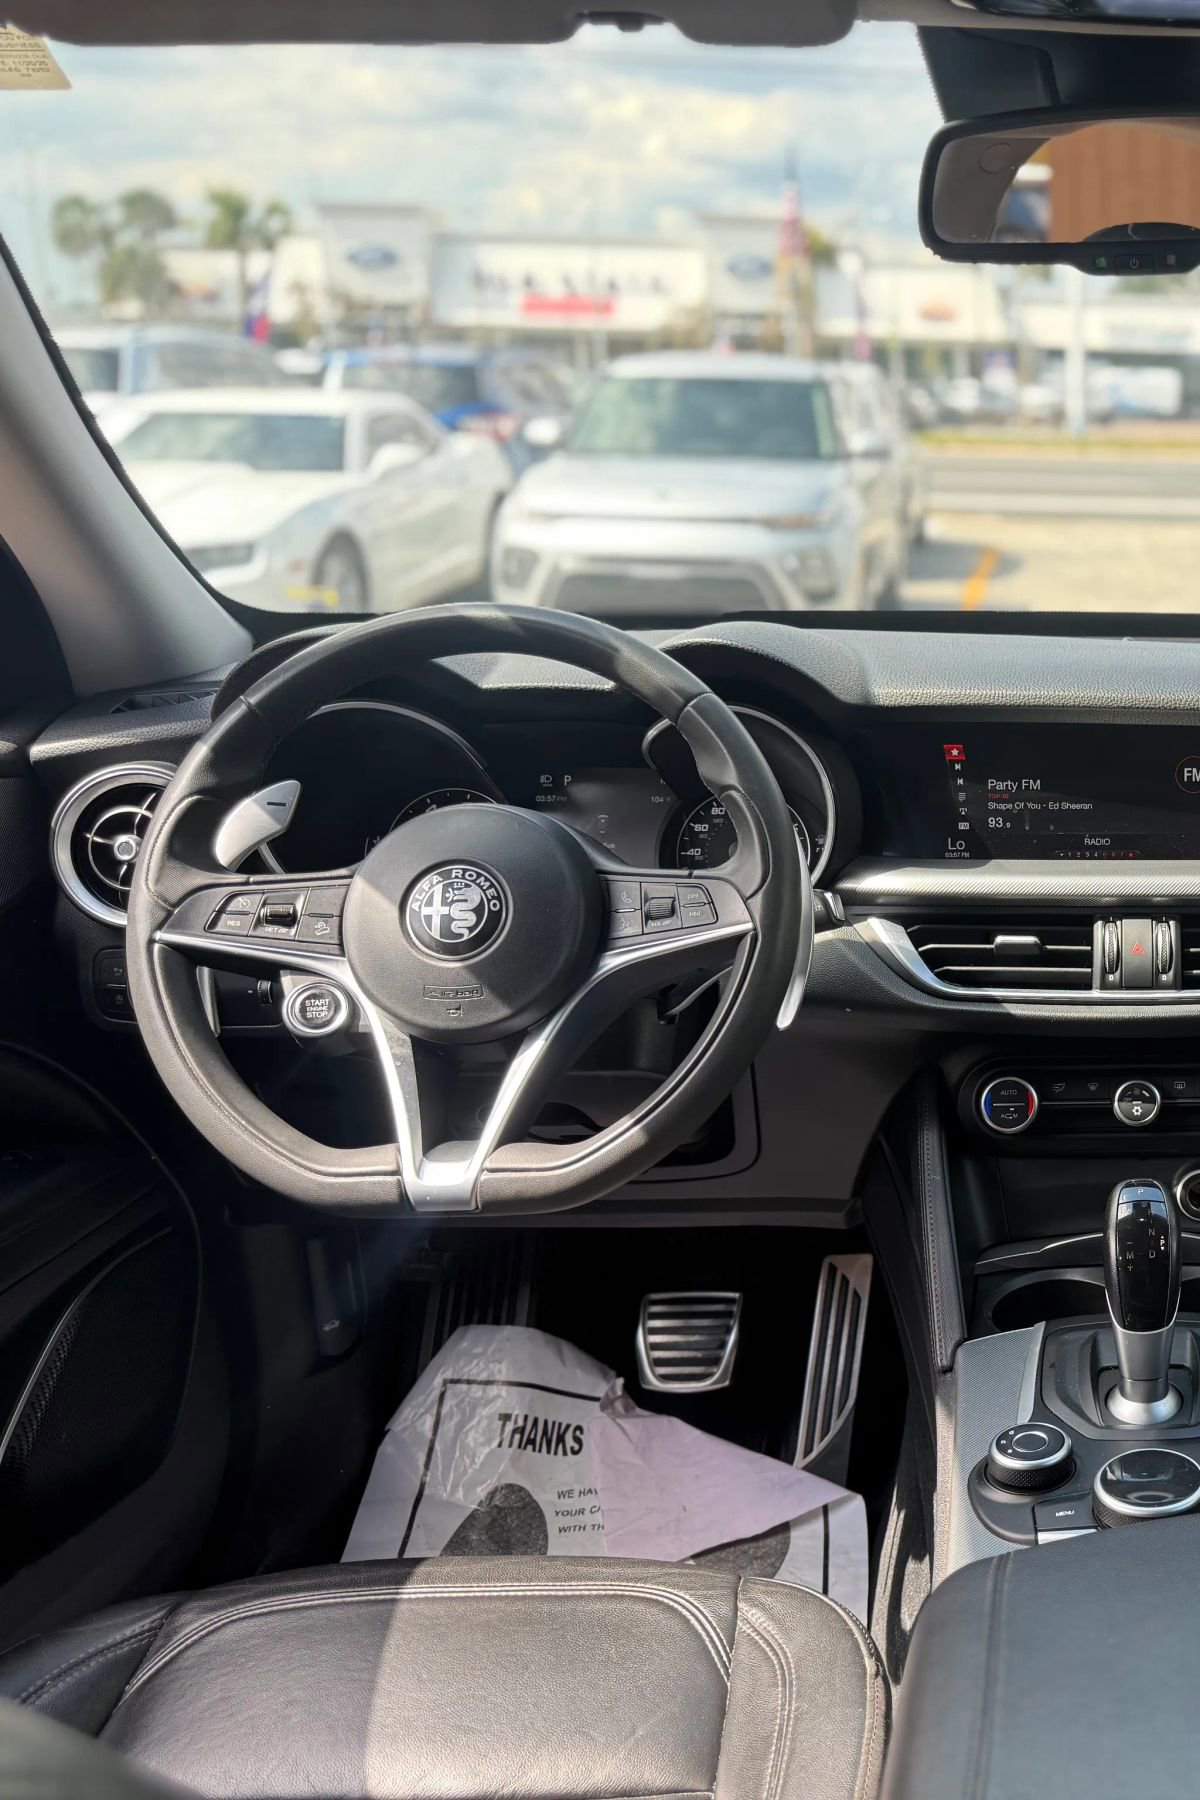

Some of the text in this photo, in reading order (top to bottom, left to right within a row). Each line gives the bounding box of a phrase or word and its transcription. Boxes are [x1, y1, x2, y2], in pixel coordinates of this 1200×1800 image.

[564, 775, 572, 786] P
[988, 779, 1041, 792] Party FM
[711, 807, 725, 815] 80
[988, 802, 1013, 811] Shape
[1014, 802, 1025, 810] Of
[1027, 802, 1041, 810] You
[1048, 802, 1059, 810] Ed
[1060, 802, 1093, 810] Sheeran
[988, 817, 1011, 829] 93.9
[694, 824, 709, 832] 60
[948, 837, 965, 850] Lo
[1084, 838, 1111, 846] RADIO
[686, 848, 701, 857] 40
[411, 869, 500, 912] ALFA ROMEO
[305, 999, 330, 1007] START
[306, 1011, 329, 1019] STOP
[1148, 1228, 1156, 1236] N
[1160, 1239, 1166, 1247] P
[1126, 1251, 1134, 1259] M
[1149, 1250, 1156, 1259] D
[497, 1412, 584, 1457] THANKS
[557, 1488, 574, 1500] WE
[554, 1507, 586, 1517] YOUR
[1055, 1509, 1075, 1517] MENU
[558, 1524, 586, 1534] WITH
